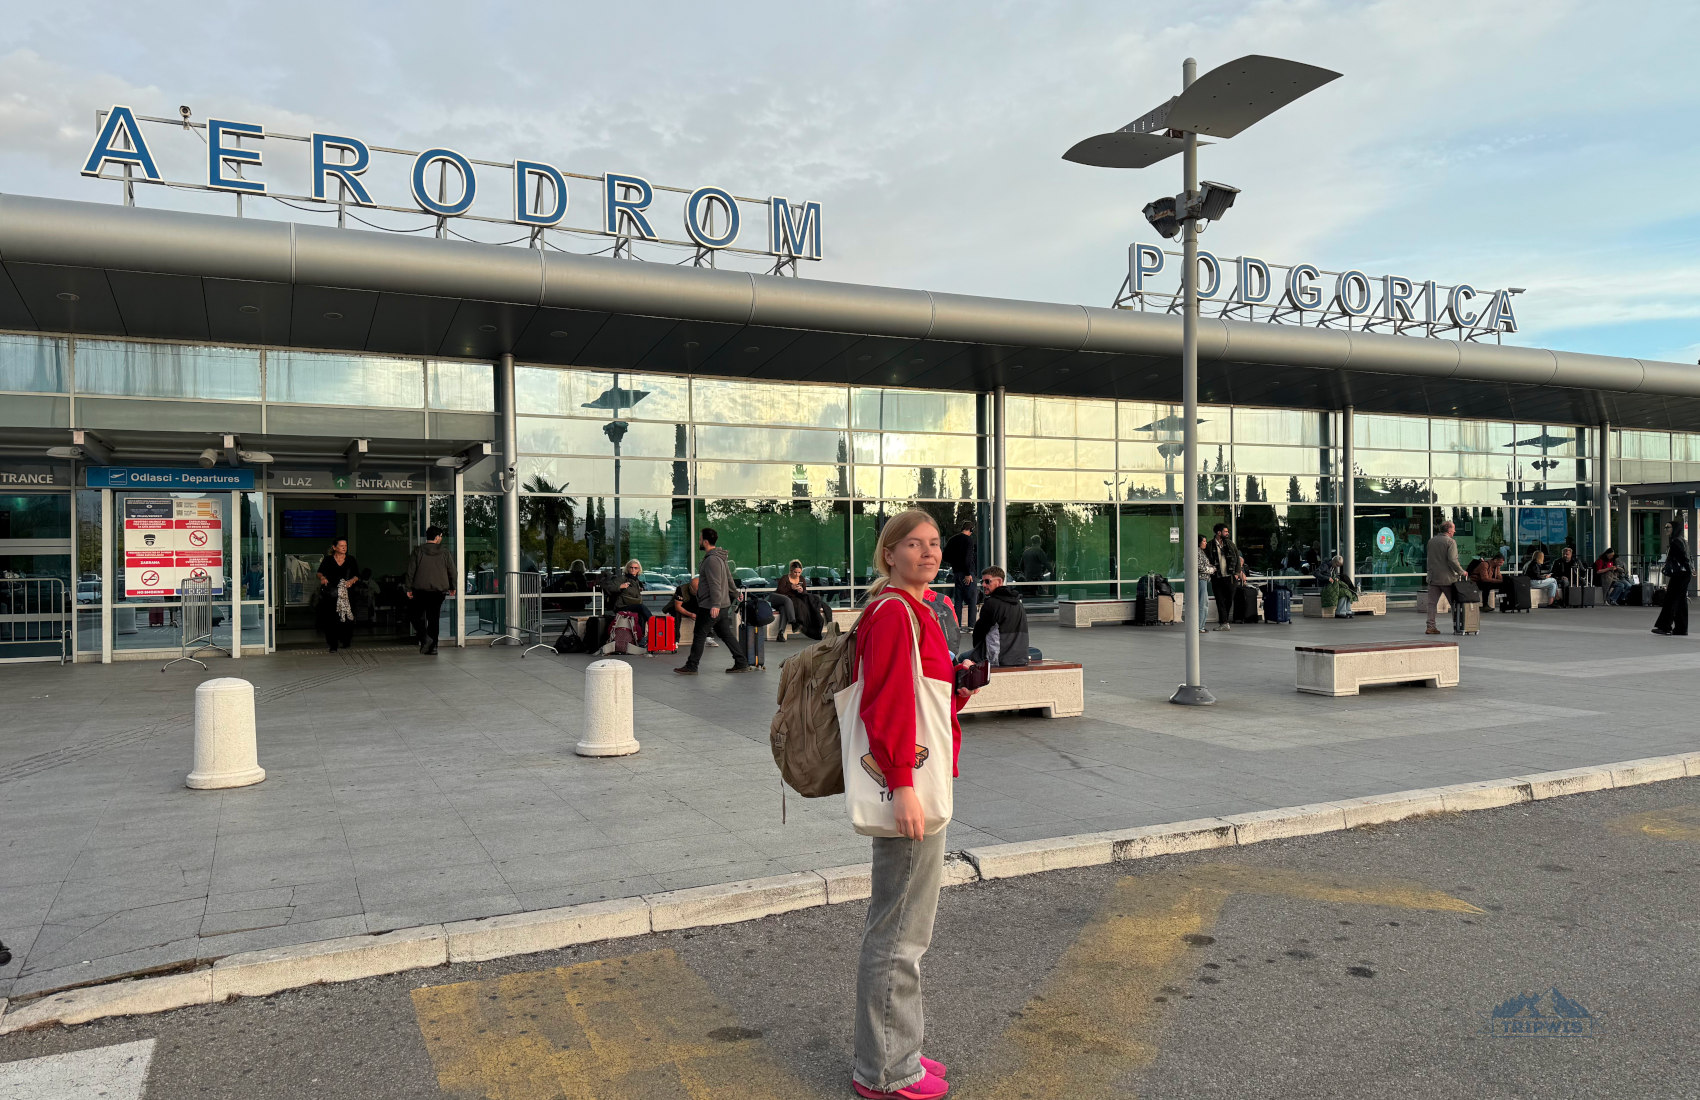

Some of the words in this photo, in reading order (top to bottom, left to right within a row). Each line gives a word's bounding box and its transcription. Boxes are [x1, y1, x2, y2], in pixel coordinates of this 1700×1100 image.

[81, 104, 823, 260] AERODROM
[1128, 242, 1520, 333] PODGORICA
[130, 472, 172, 483] Odlasci
[181, 473, 240, 484] Departures
[282, 476, 313, 487] ULAZ
[355, 478, 413, 489] ENTRANCE
